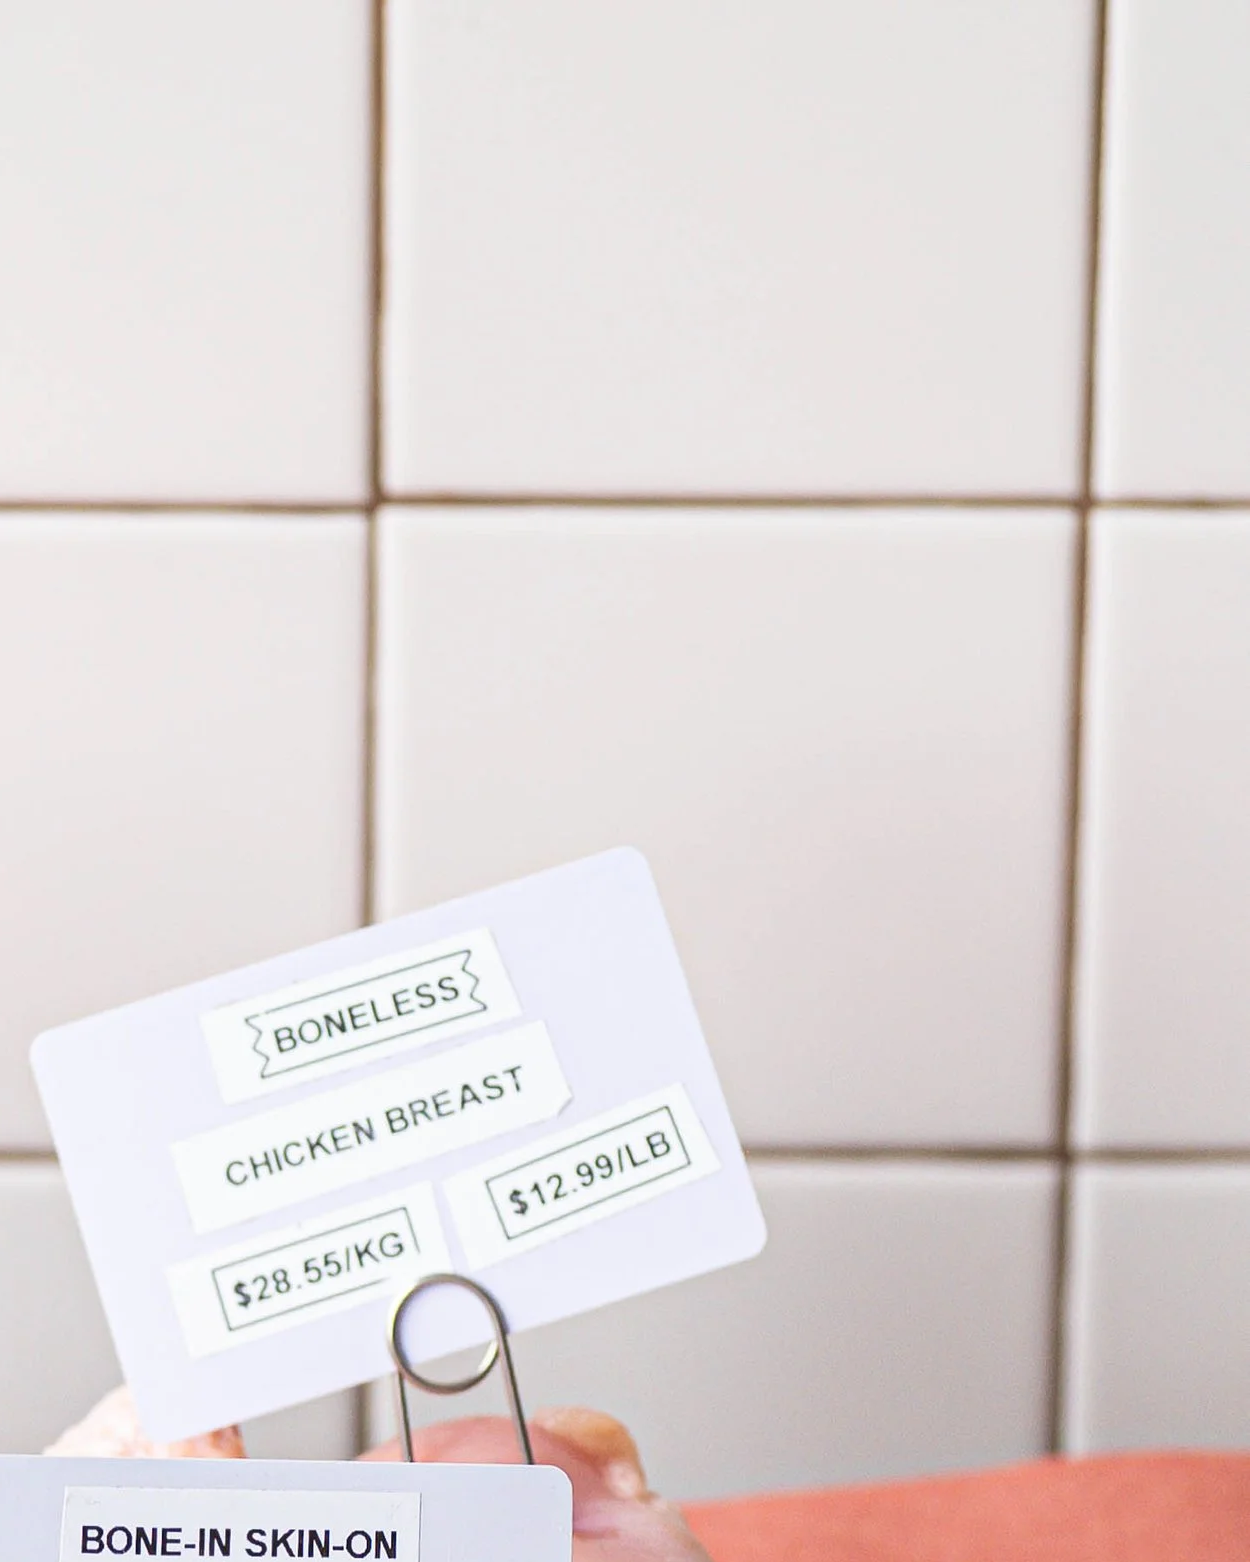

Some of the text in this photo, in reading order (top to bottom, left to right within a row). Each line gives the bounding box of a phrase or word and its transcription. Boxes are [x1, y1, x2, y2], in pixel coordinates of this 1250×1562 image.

[274, 976, 459, 1053] BONELESS
[226, 1065, 521, 1186] CHICKEN BREAST
[509, 1132, 671, 1215] $12.99/LB
[234, 1232, 404, 1308] $28.55/KG
[80, 1525, 397, 1560] BONE-IN SKIN-ON
